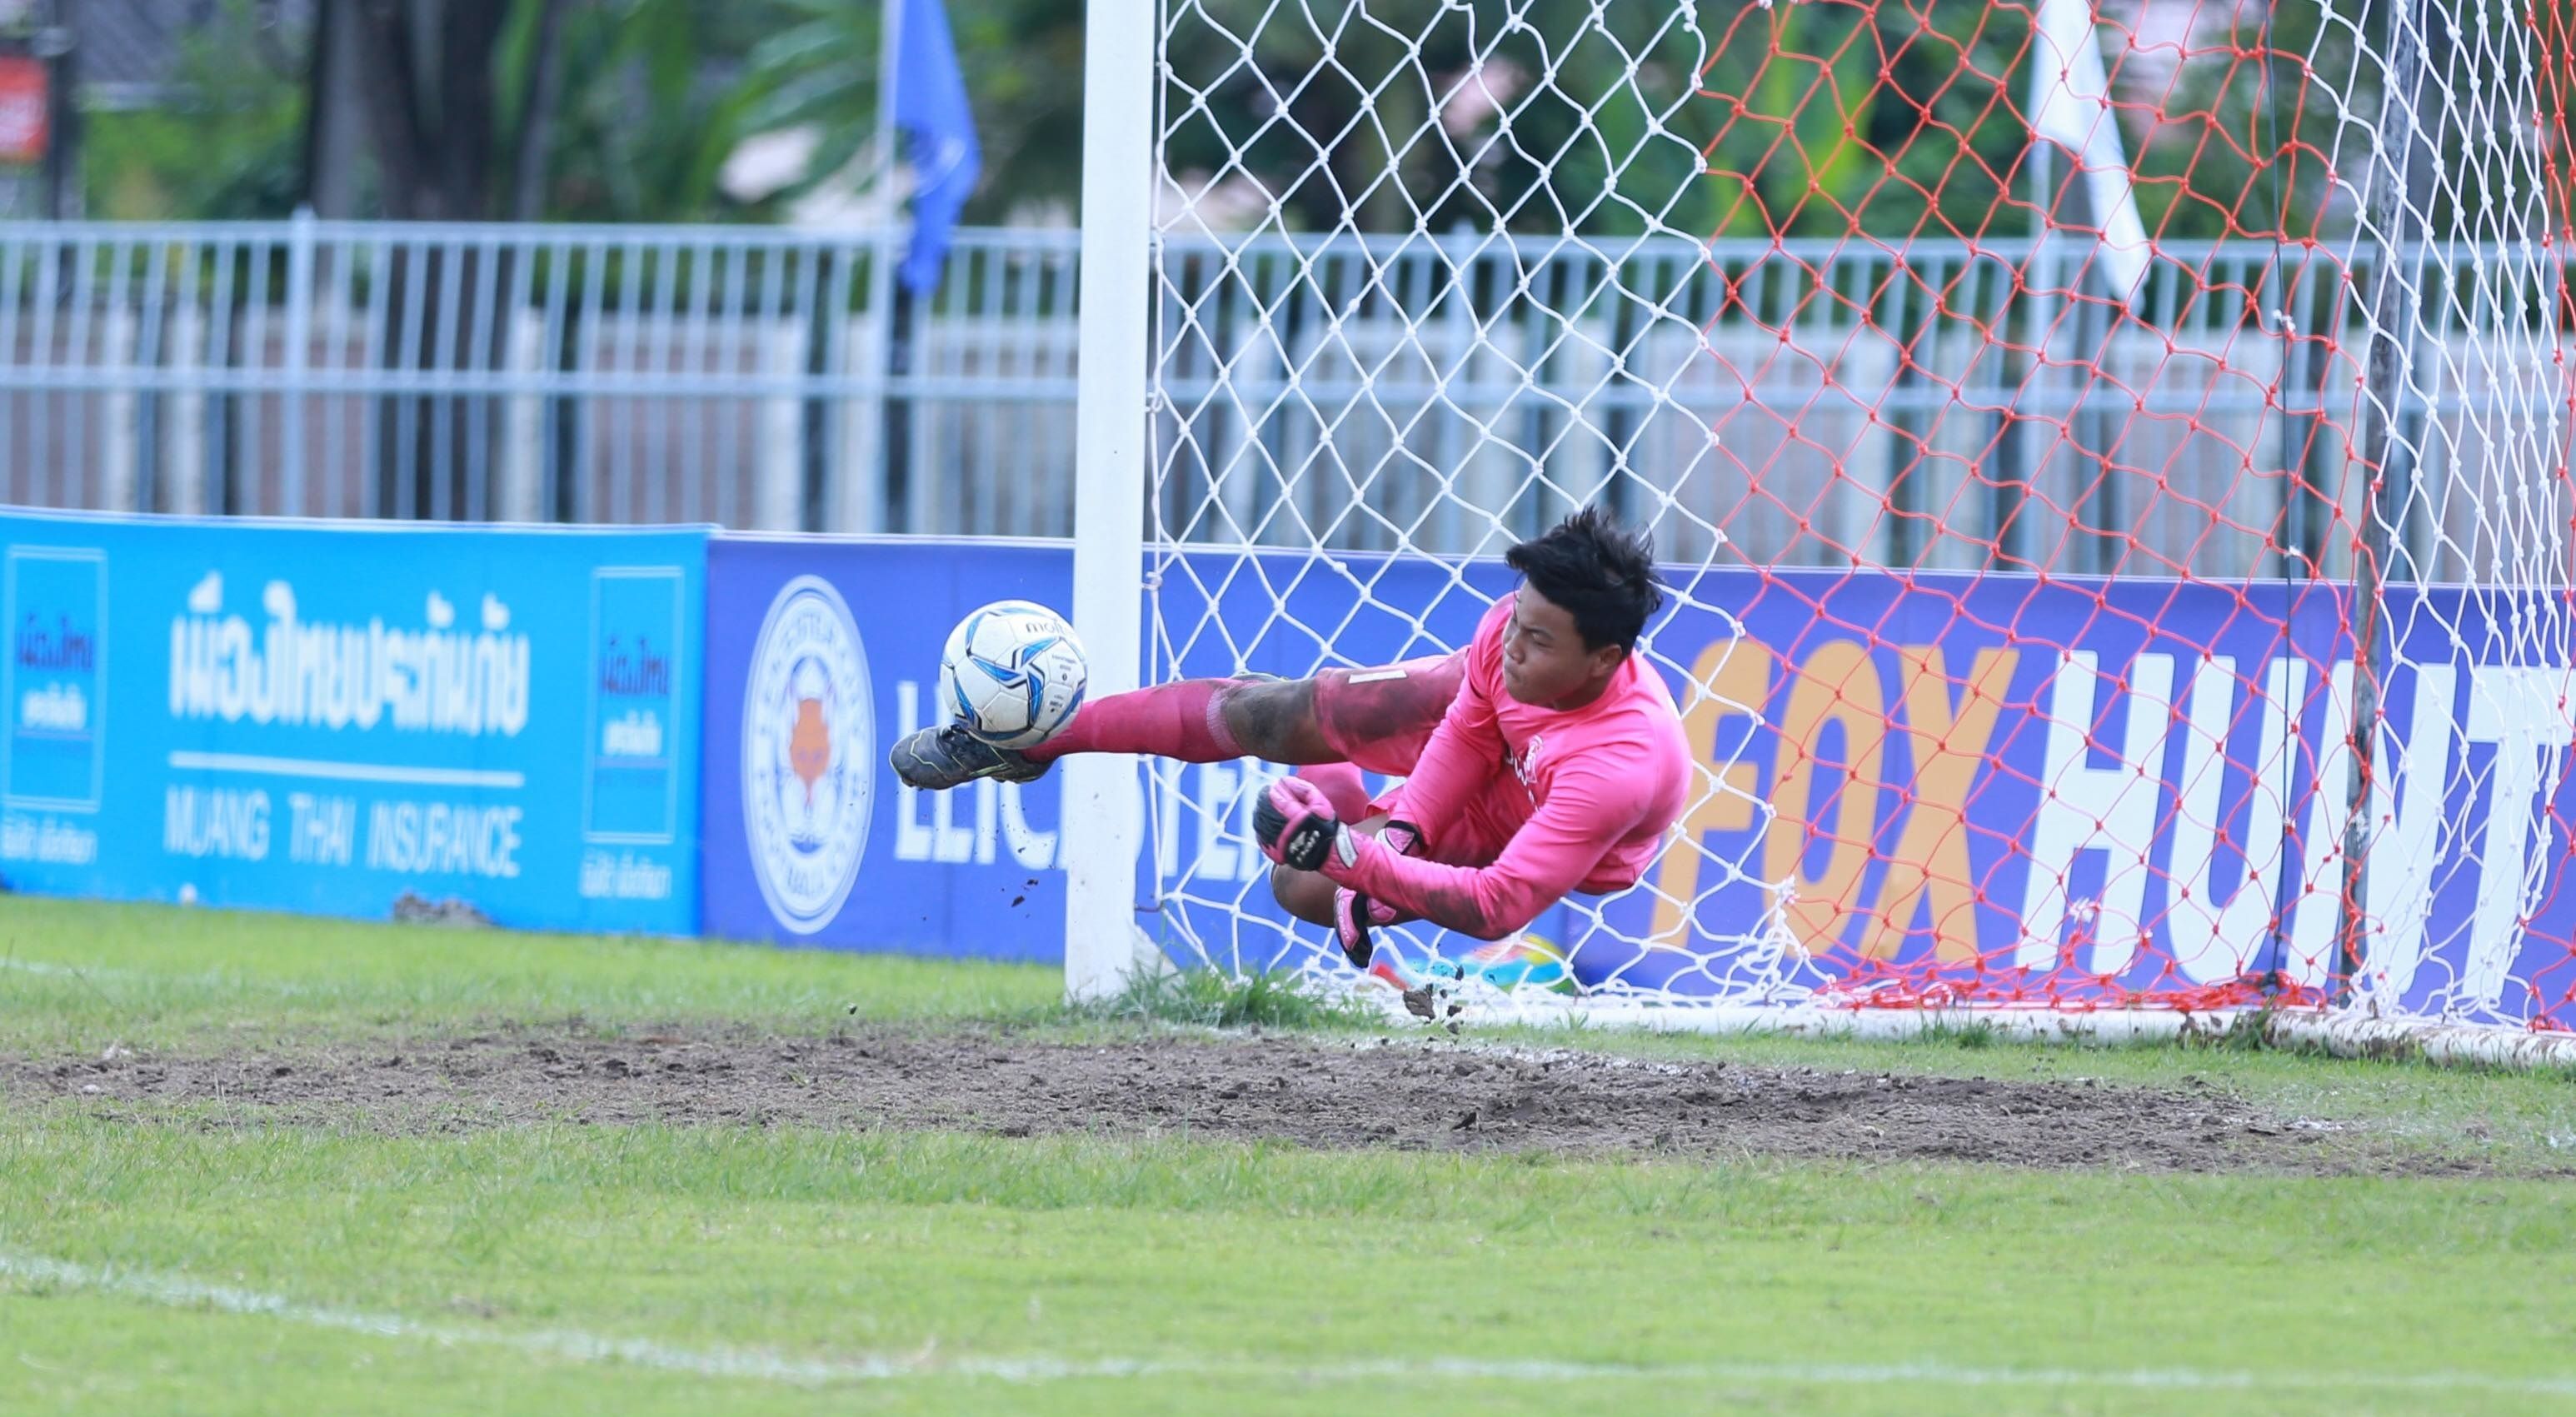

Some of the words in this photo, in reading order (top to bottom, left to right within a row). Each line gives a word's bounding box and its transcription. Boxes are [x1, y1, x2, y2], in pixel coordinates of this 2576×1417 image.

[165, 786, 271, 861] MUANG
[289, 793, 356, 866] THAI
[367, 801, 523, 879] INSURANCE
[1649, 638, 2019, 964] FOX
[2014, 649, 2576, 1000] HUNT
